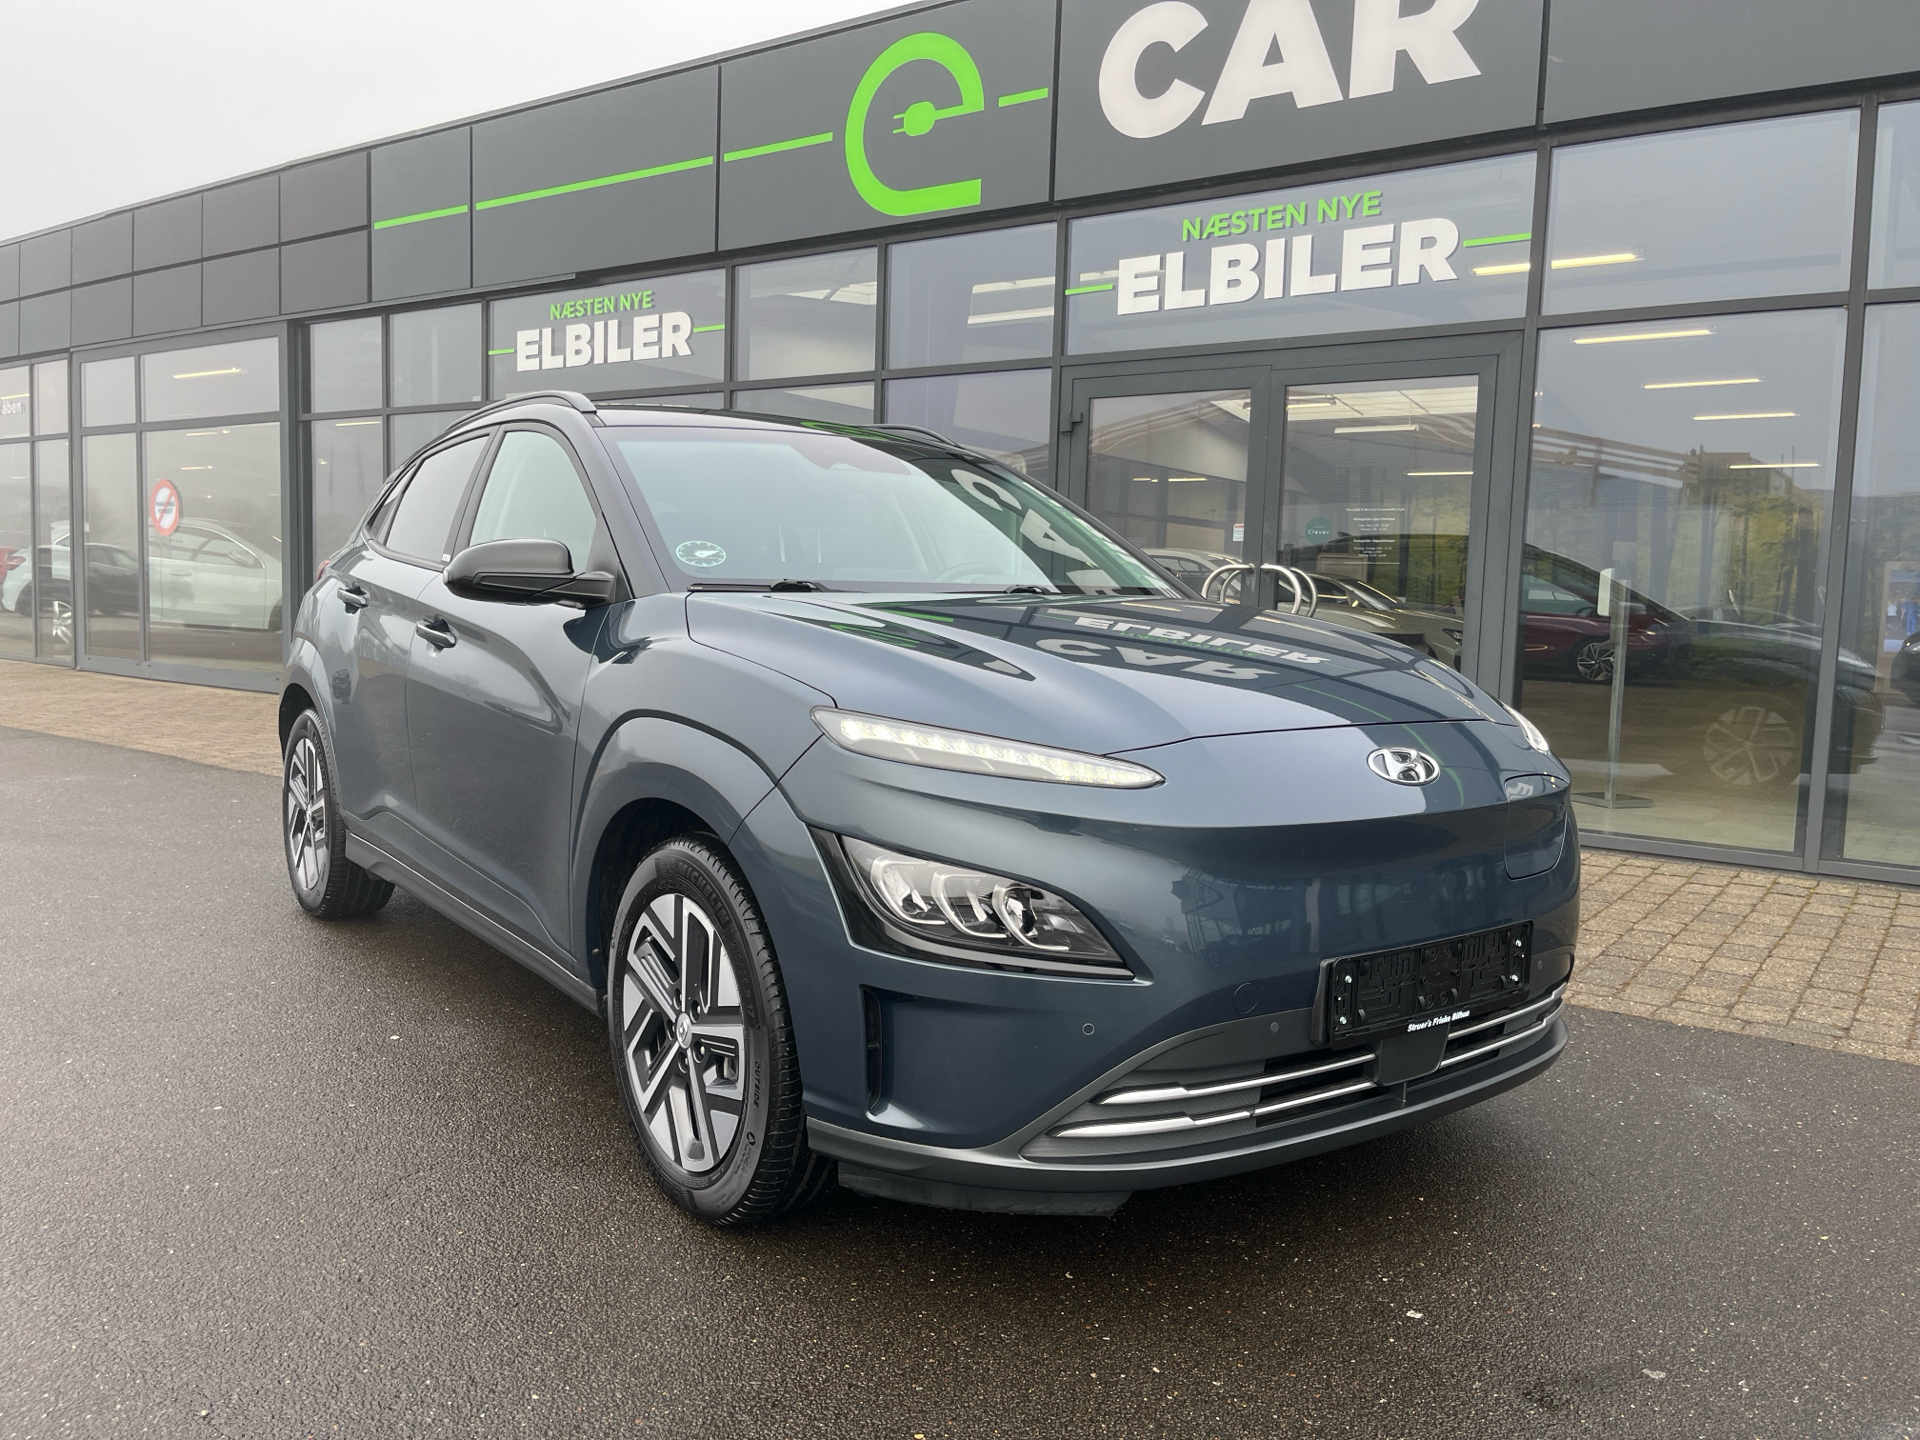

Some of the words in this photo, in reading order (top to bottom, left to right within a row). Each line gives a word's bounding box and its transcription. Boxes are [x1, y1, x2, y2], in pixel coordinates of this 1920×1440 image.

[1099, 0, 1482, 138] CAR
[1182, 202, 1307, 241] NÆSTEN
[1318, 190, 1383, 224] NYE
[1117, 217, 1459, 315] ELBILER
[549, 296, 615, 321] NÆSTEN
[619, 290, 653, 311] NYE
[516, 311, 692, 372] ELBILER
[676, 862, 731, 927] MICHELIN
[753, 1061, 761, 1109] OUTSIDE
